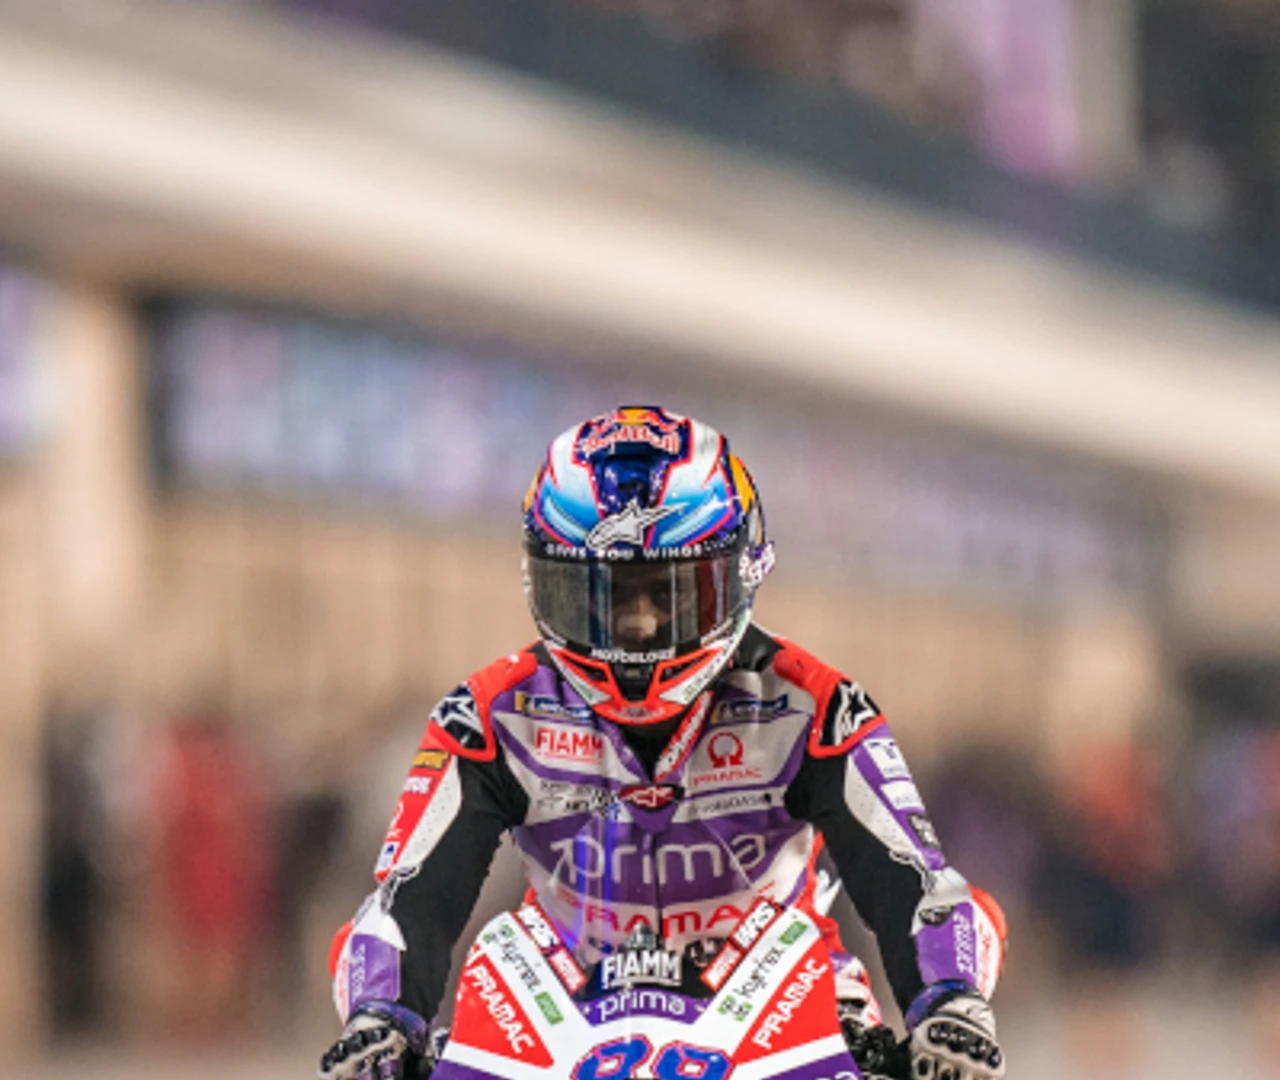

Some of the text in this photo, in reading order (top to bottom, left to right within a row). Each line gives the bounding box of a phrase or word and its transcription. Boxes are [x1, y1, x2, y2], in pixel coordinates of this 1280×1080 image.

[549, 831, 767, 885] prima
[601, 950, 681, 989] FIAMM
[464, 962, 535, 1054] PRAMAC
[597, 991, 686, 1021] prima
[752, 956, 829, 1050] PRAMAC
